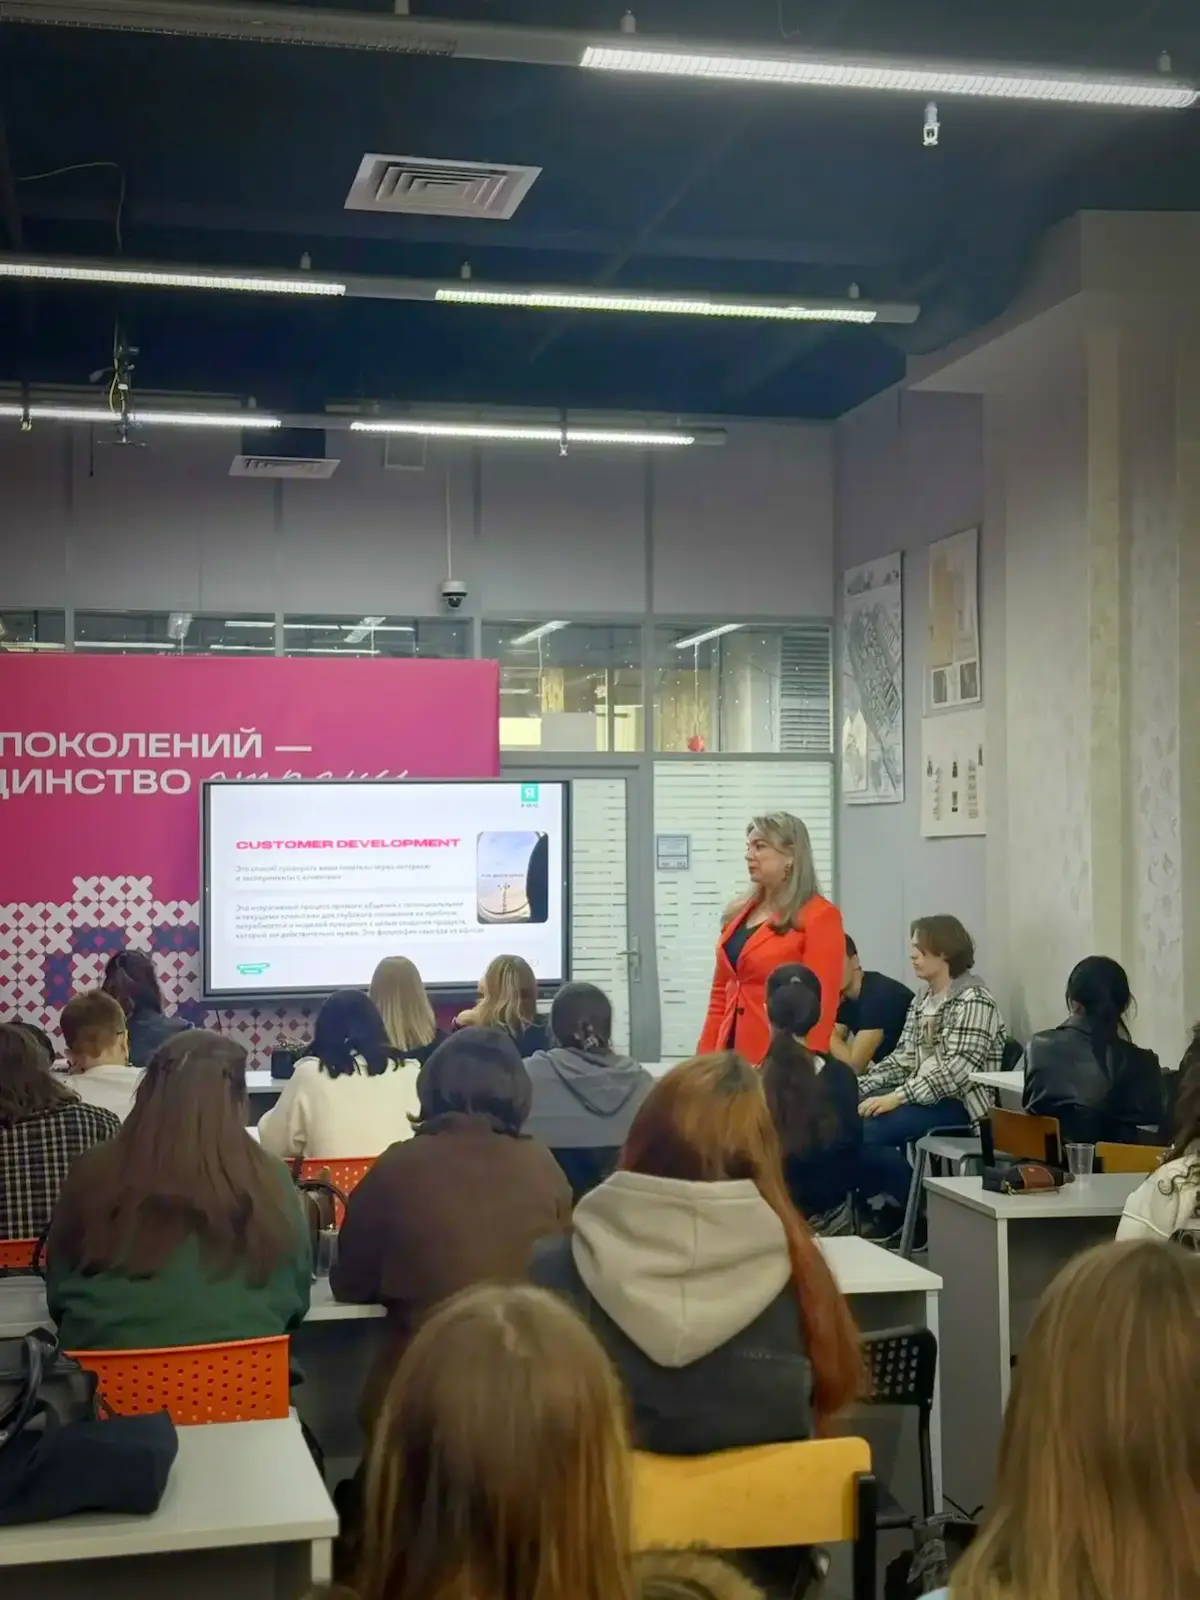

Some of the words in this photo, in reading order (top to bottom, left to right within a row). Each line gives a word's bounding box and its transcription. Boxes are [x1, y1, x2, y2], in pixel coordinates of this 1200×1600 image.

[0, 727, 262, 758] ПОКОЛЕНИЙ
[235, 839, 333, 850] CUSTOMER
[336, 838, 461, 849] DEVELOPMENT
